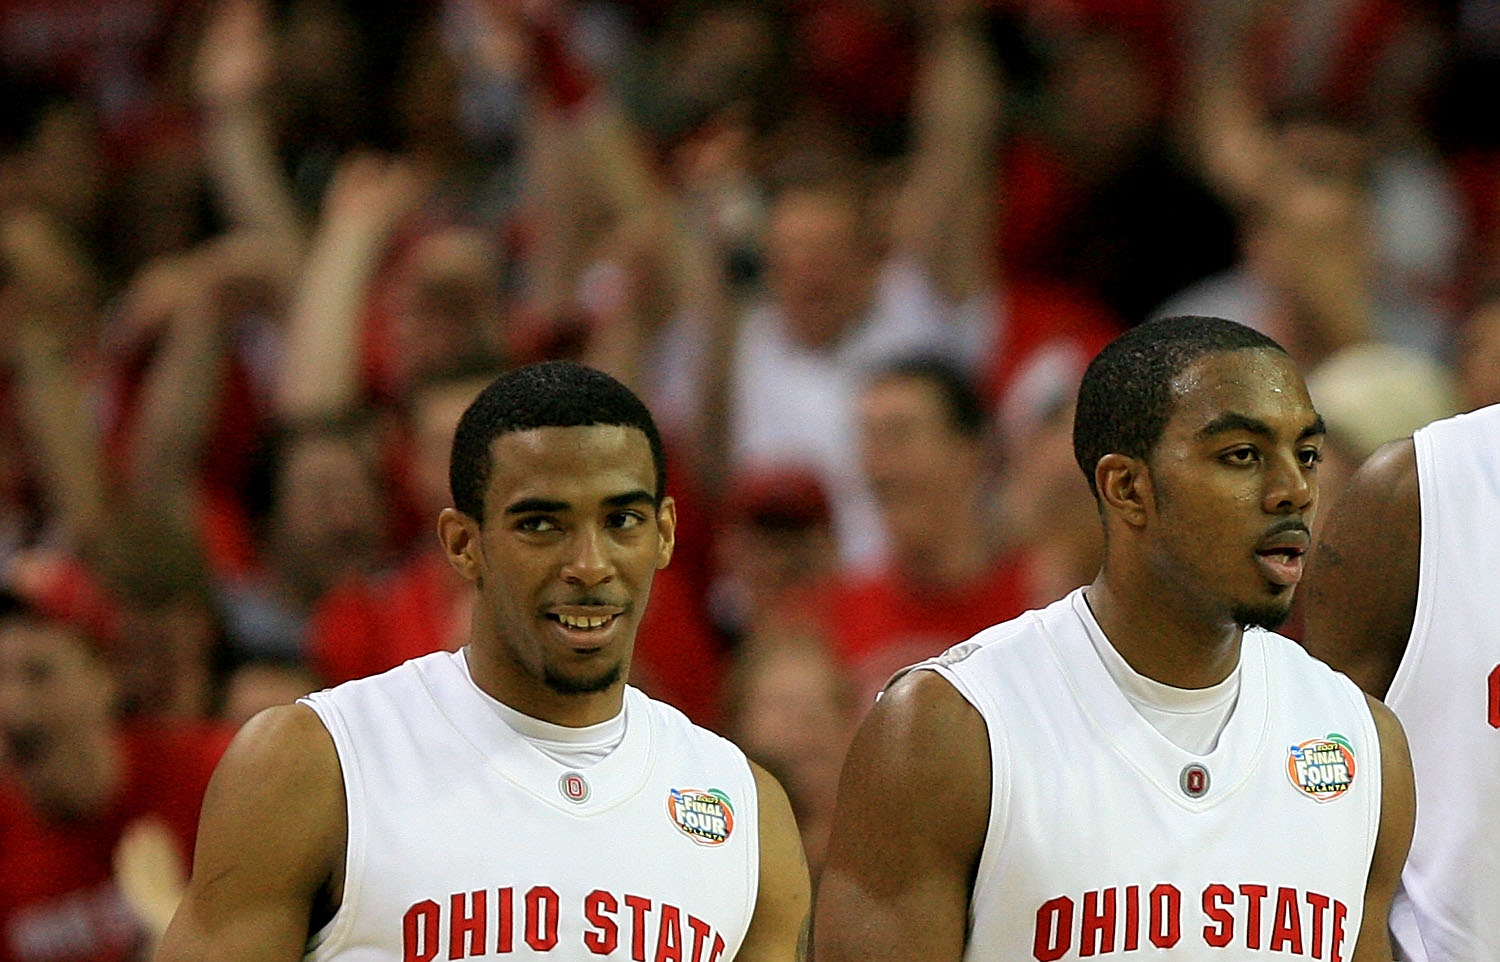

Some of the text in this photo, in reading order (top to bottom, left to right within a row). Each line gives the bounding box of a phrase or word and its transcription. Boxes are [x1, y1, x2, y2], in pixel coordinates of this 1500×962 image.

[1303, 749, 1344, 766] FINAL
[1295, 760, 1350, 787] FOUR
[674, 801, 727, 837] FOUR
[683, 795, 724, 819] FINAL
[1034, 883, 1181, 962] OHIO
